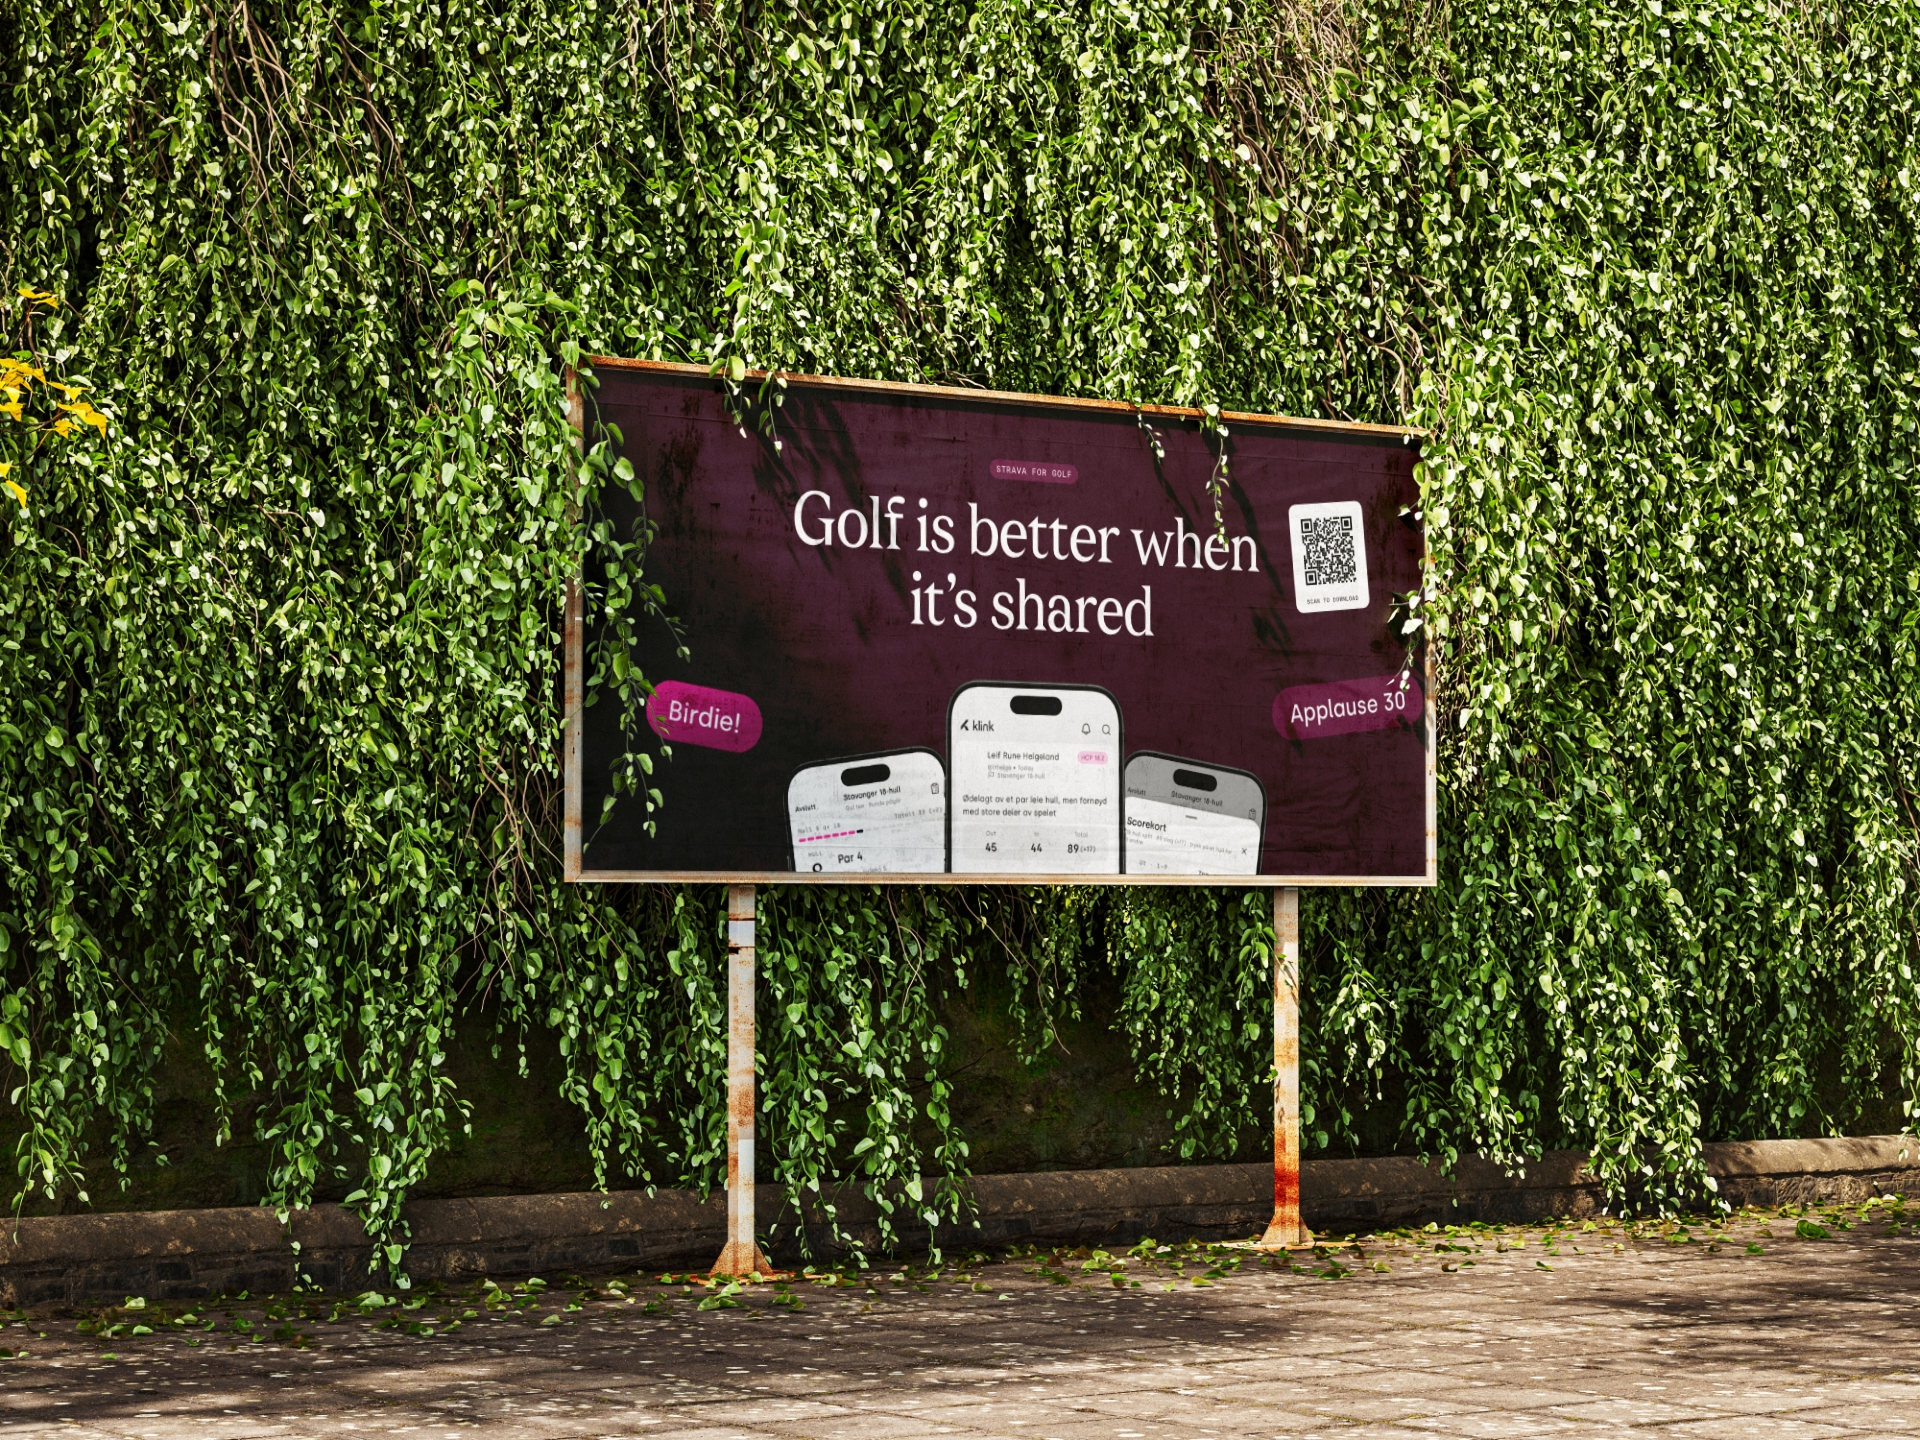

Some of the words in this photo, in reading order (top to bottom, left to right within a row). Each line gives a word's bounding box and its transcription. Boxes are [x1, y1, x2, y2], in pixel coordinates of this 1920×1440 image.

[996, 465, 1027, 475] STRAVA
[1032, 467, 1047, 477] FOR
[1052, 469, 1072, 478] GOLF
[793, 490, 905, 550] Golf
[916, 497, 955, 554] is
[967, 502, 1120, 564] better
[1130, 516, 1260, 573] when
[991, 578, 1154, 637] shared
[1290, 698, 1378, 728] Applause
[1383, 690, 1406, 712] 30
[668, 699, 741, 734] Birdie!
[972, 720, 995, 732] klink
[987, 752, 1001, 760] Leif
[1003, 752, 1021, 760] Rune
[1023, 752, 1059, 762] Helgeland
[843, 791, 877, 801] Stavanger
[1127, 787, 1147, 796] Avslutt
[1170, 790, 1202, 804] Stavanger
[962, 794, 993, 804] Ødelagt
[1015, 796, 1028, 805] par
[1079, 796, 1108, 806] fornøyd
[795, 804, 817, 813] Avslutt
[962, 808, 980, 816] med
[1002, 808, 1021, 816] deler
[1033, 809, 1057, 817] spelet
[1126, 816, 1167, 832] Scorekort
[985, 842, 998, 853] 45
[1030, 843, 1043, 853] 44
[1067, 844, 1080, 854] 89
[837, 853, 854, 864] Par
[857, 852, 864, 861] 4
